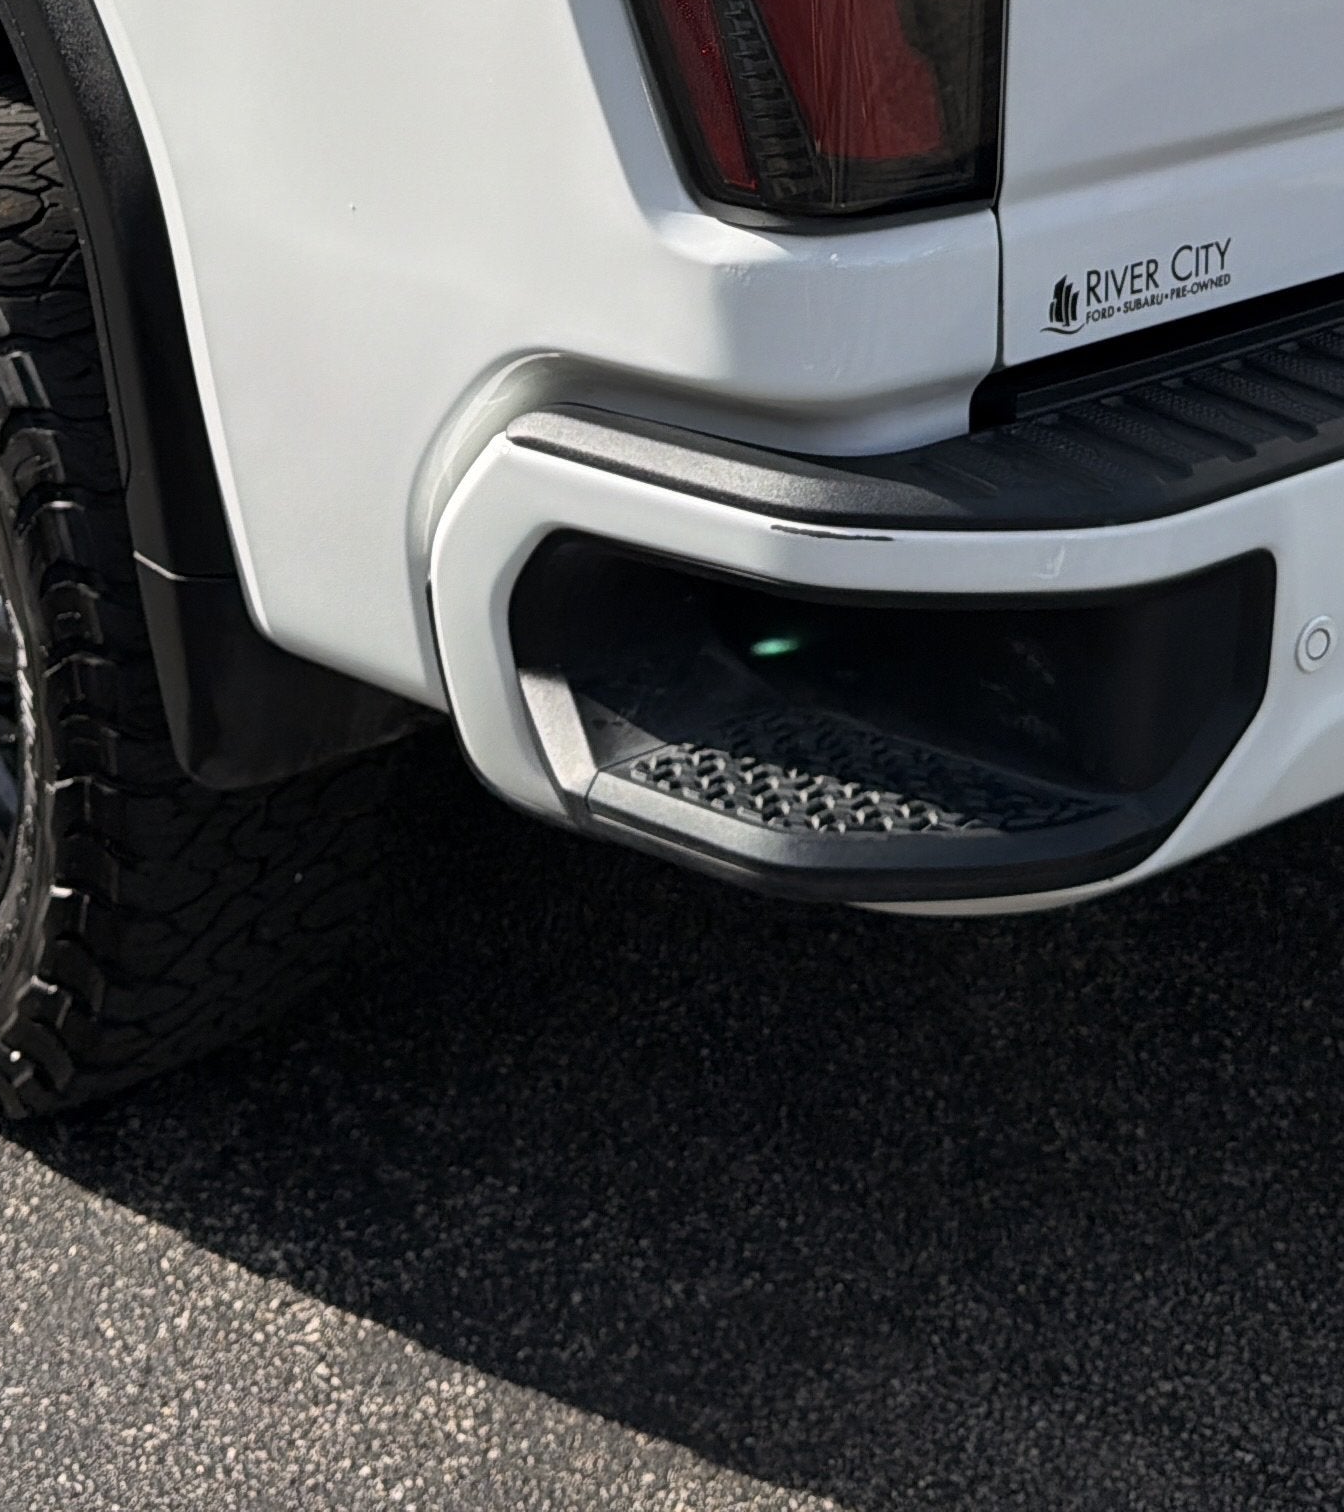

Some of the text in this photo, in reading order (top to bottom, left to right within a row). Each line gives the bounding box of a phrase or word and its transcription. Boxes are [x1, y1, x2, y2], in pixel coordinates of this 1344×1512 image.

[1085, 237, 1232, 307] RIVER CITY
[1085, 273, 1232, 325] FORD SUBARU PRE-OWNED
